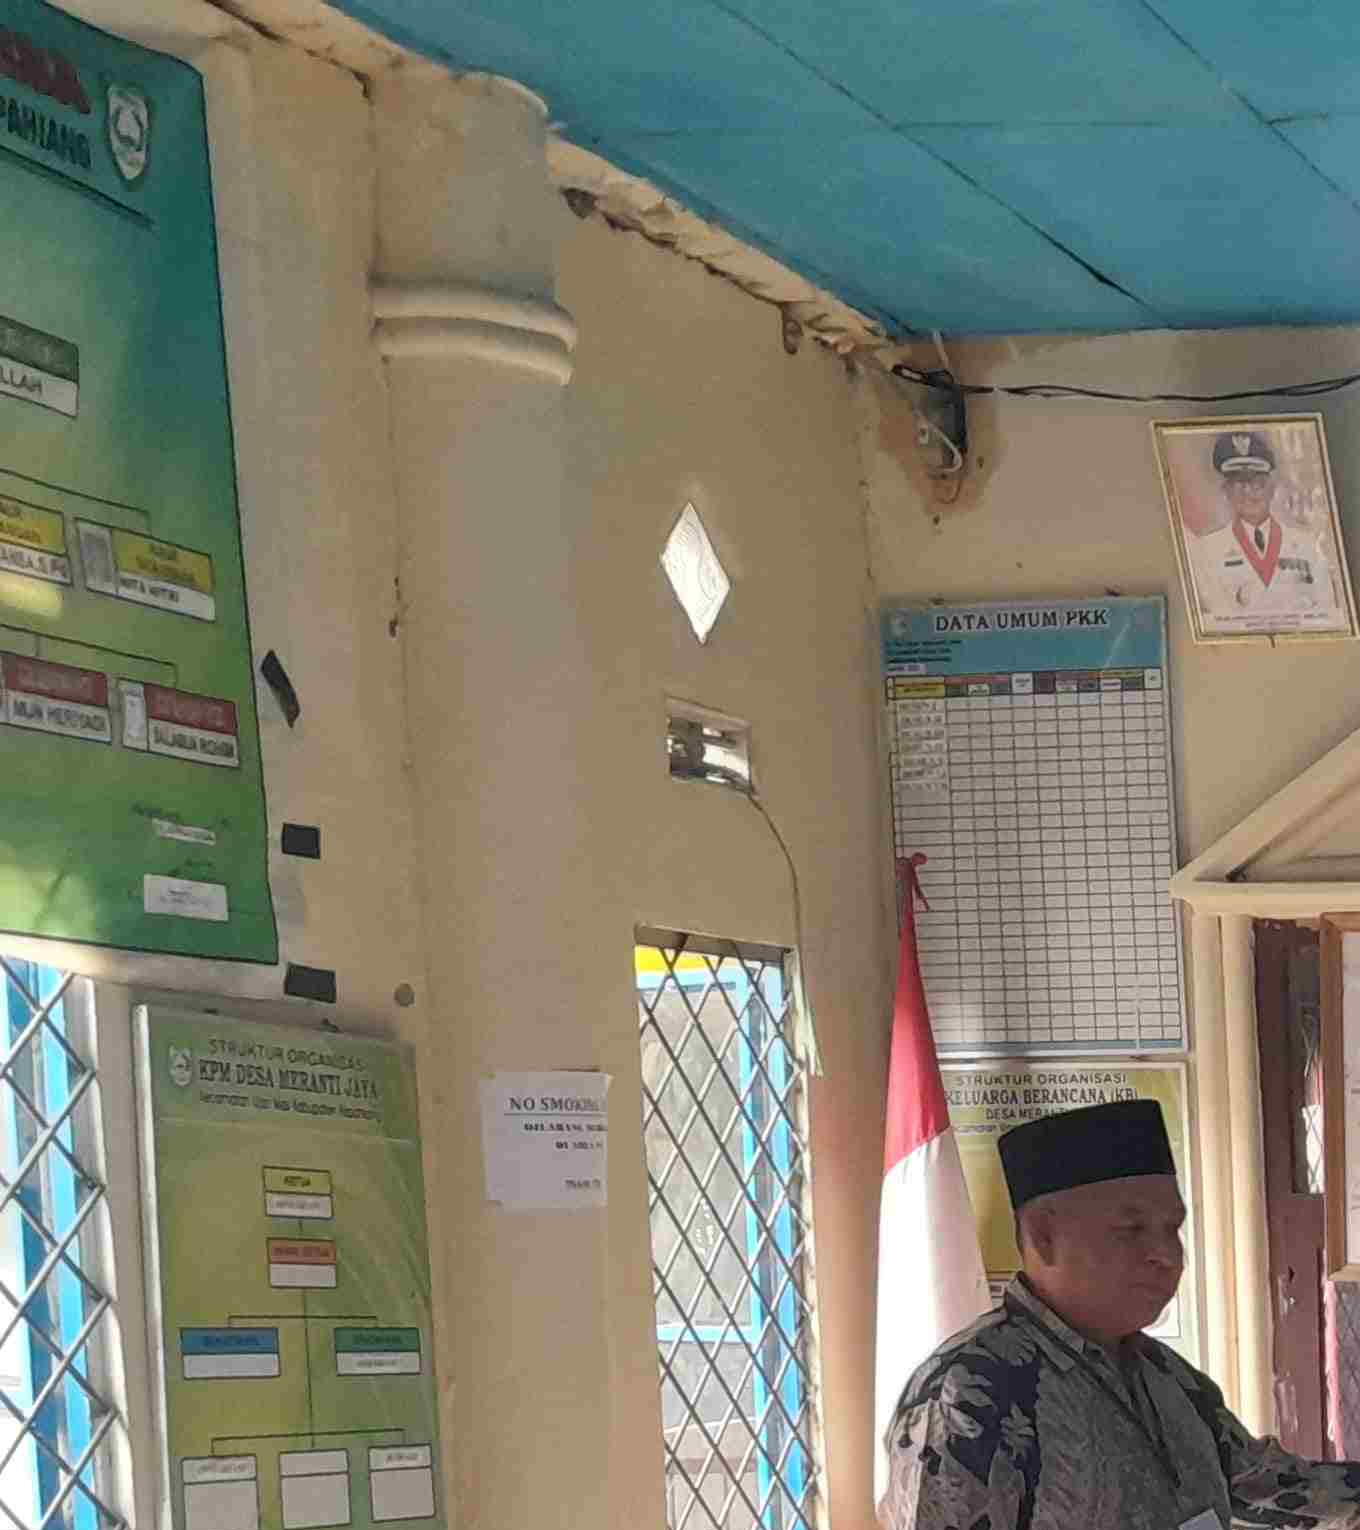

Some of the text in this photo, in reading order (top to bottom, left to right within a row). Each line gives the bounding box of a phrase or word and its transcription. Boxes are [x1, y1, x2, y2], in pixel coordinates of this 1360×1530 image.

[936, 609, 1108, 631] DATA UMUM PKK
[209, 1038, 282, 1061] STRUKTUR
[236, 1063, 275, 1089] DESA
[345, 1077, 379, 1101] JAYA
[959, 1072, 1127, 1086] STRUKTUR ORGANISASI
[509, 1097, 535, 1112] NO
